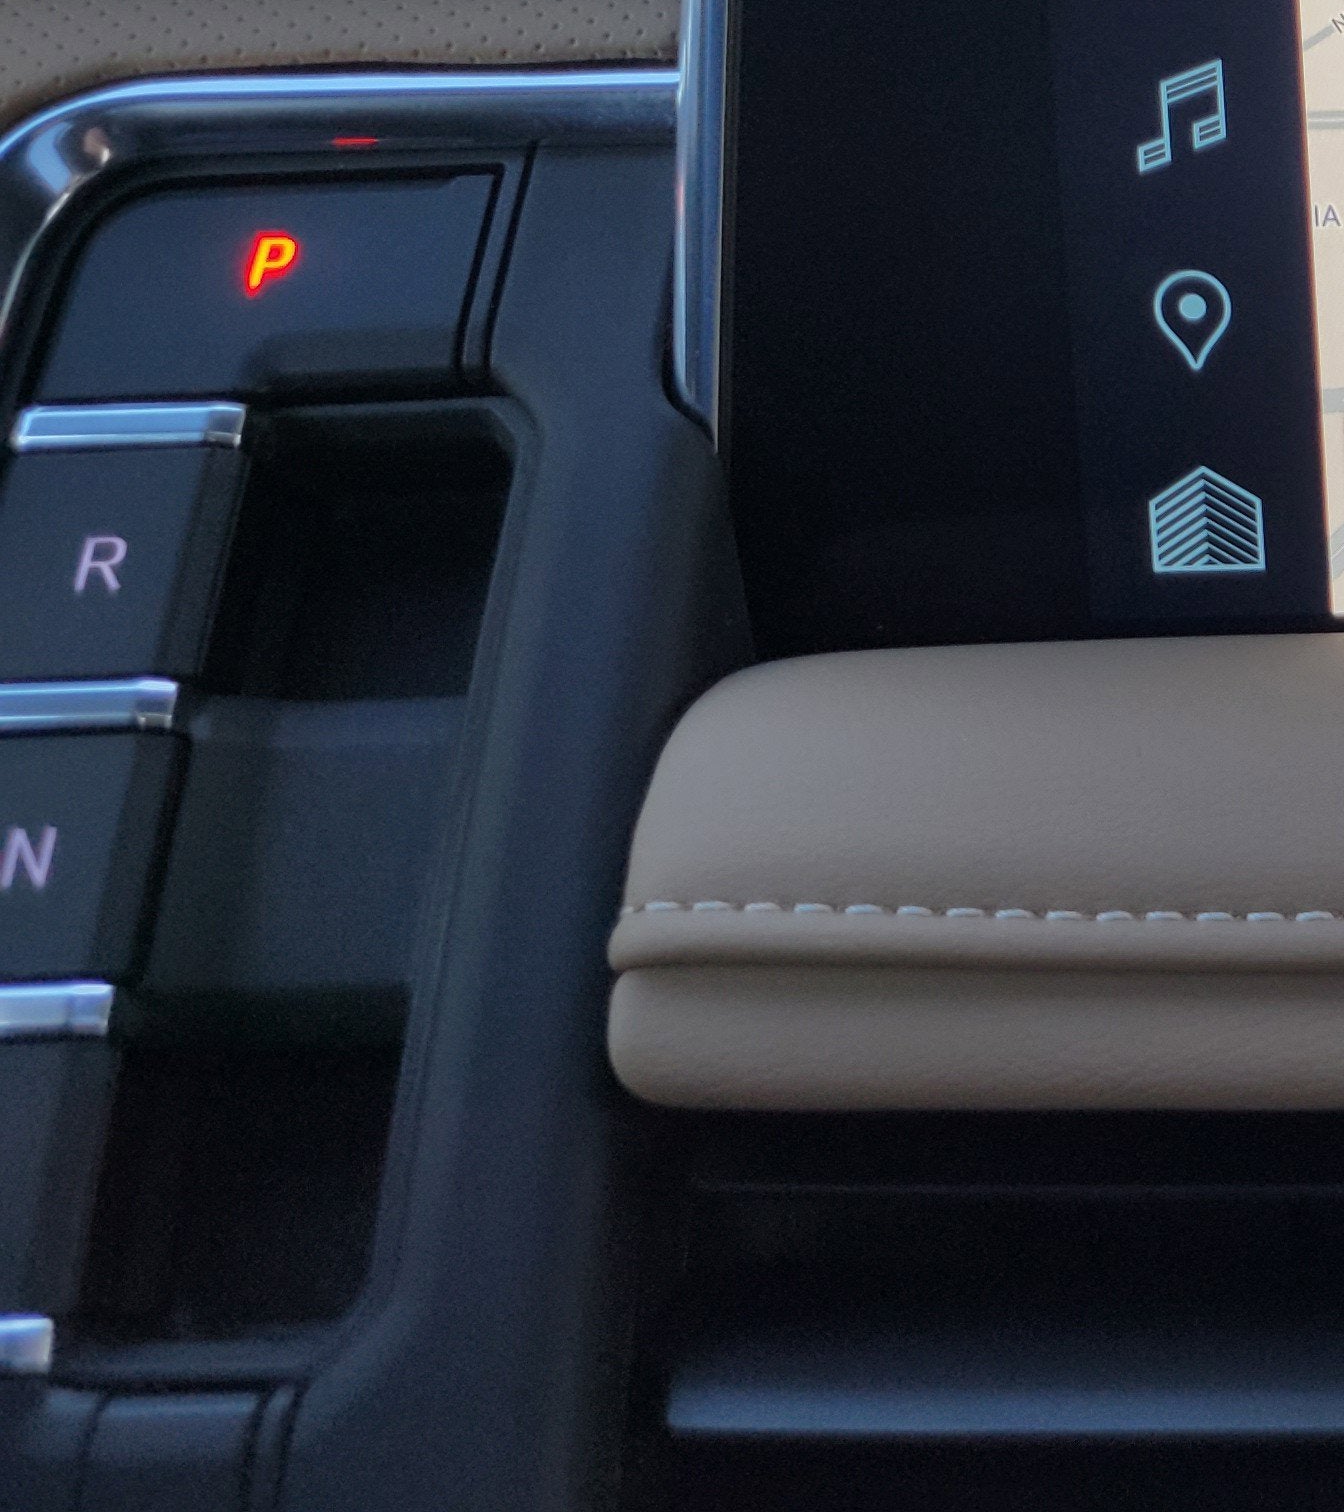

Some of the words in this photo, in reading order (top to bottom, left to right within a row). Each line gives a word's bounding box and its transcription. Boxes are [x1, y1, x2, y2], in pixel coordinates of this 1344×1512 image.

[246, 230, 299, 297] P
[73, 534, 128, 594] R
[2, 826, 57, 888] N
